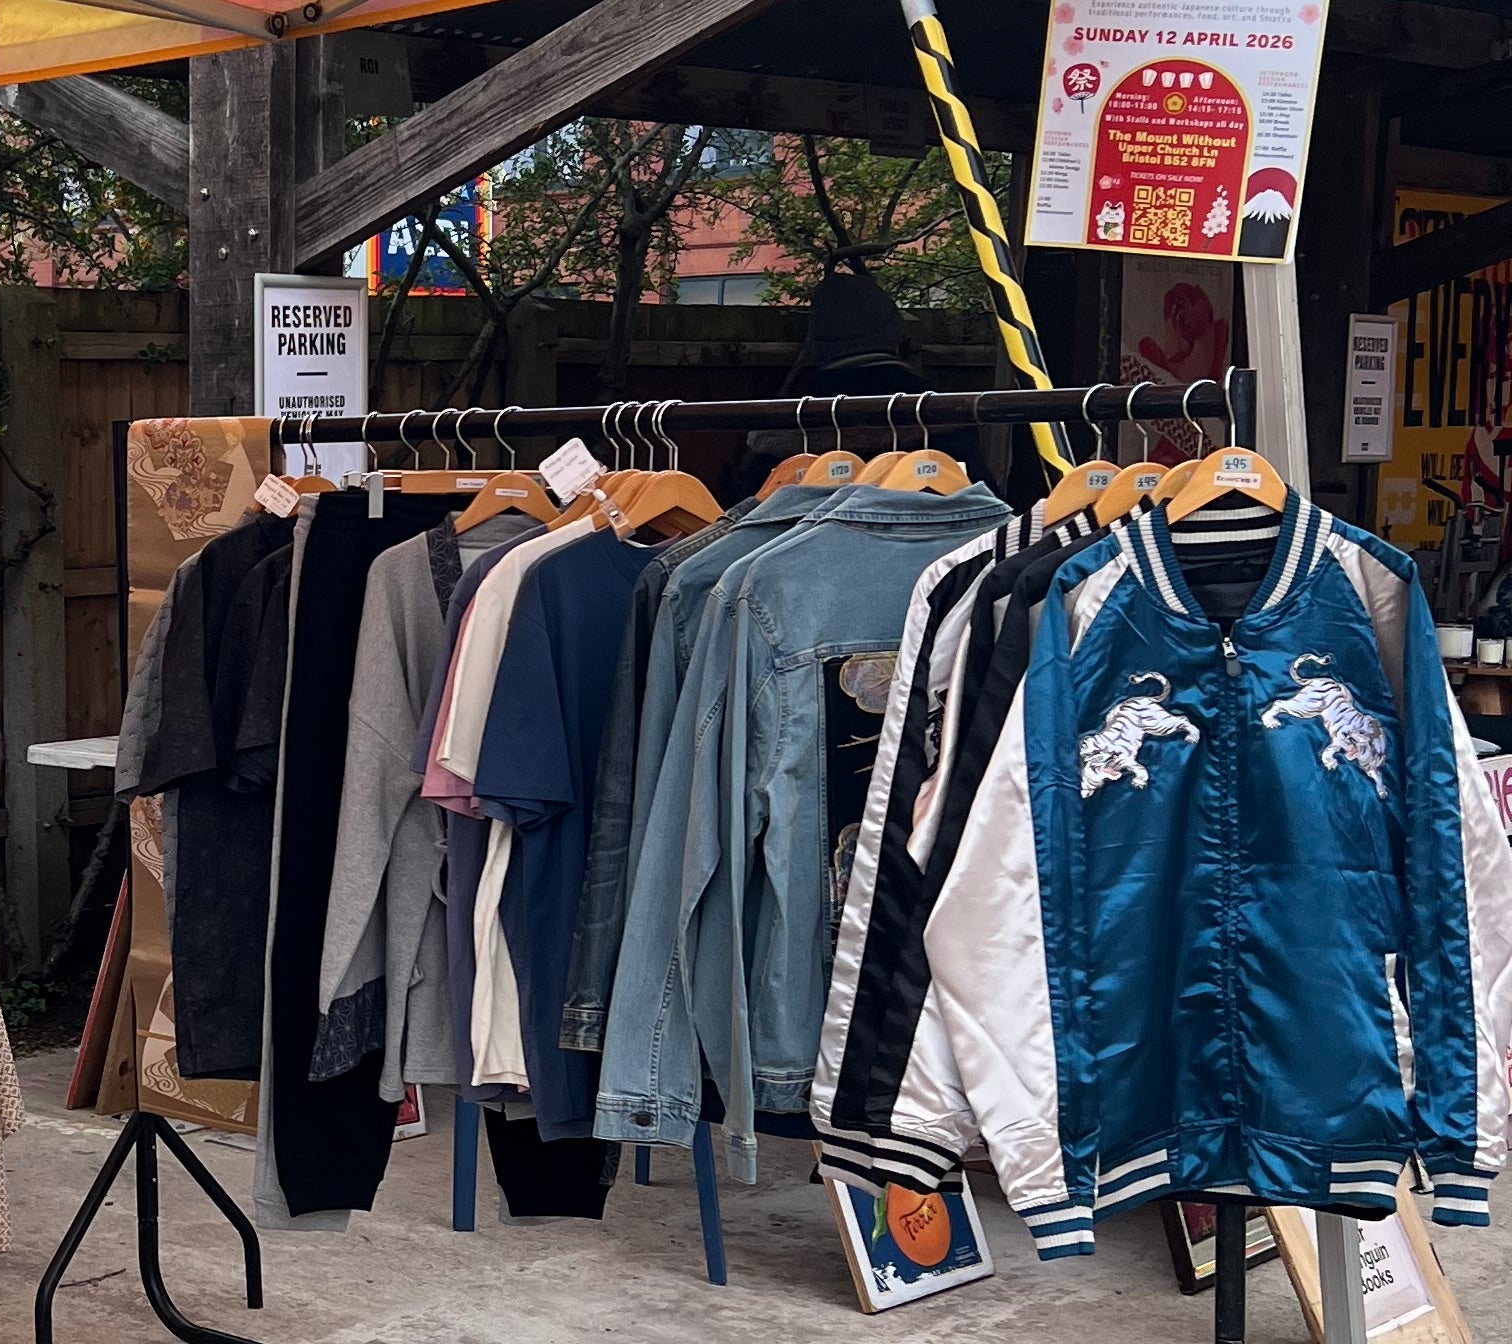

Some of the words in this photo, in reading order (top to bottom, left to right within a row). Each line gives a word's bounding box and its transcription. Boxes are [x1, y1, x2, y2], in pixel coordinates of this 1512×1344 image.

[1073, 27, 1149, 43] SUNDAY
[1156, 30, 1177, 45] 12
[1183, 32, 1239, 47] APRIL
[1246, 34, 1294, 49] 2026
[1067, 68, 1098, 92] 祭
[1108, 129, 1132, 142] The
[1135, 131, 1178, 144] Mount
[1182, 134, 1236, 147] Without
[1118, 142, 1154, 154] Upper
[1157, 144, 1199, 156] Church
[1203, 147, 1219, 157] Ln
[1122, 152, 1161, 164] Bristol
[1164, 155, 1188, 166] BS2
[1191, 157, 1216, 168] 8FN
[271, 305, 353, 328] RESERVED
[278, 332, 346, 356] PARKING
[279, 395, 346, 409] UNAUTHORISED
[1359, 1243, 1390, 1270] nguin
